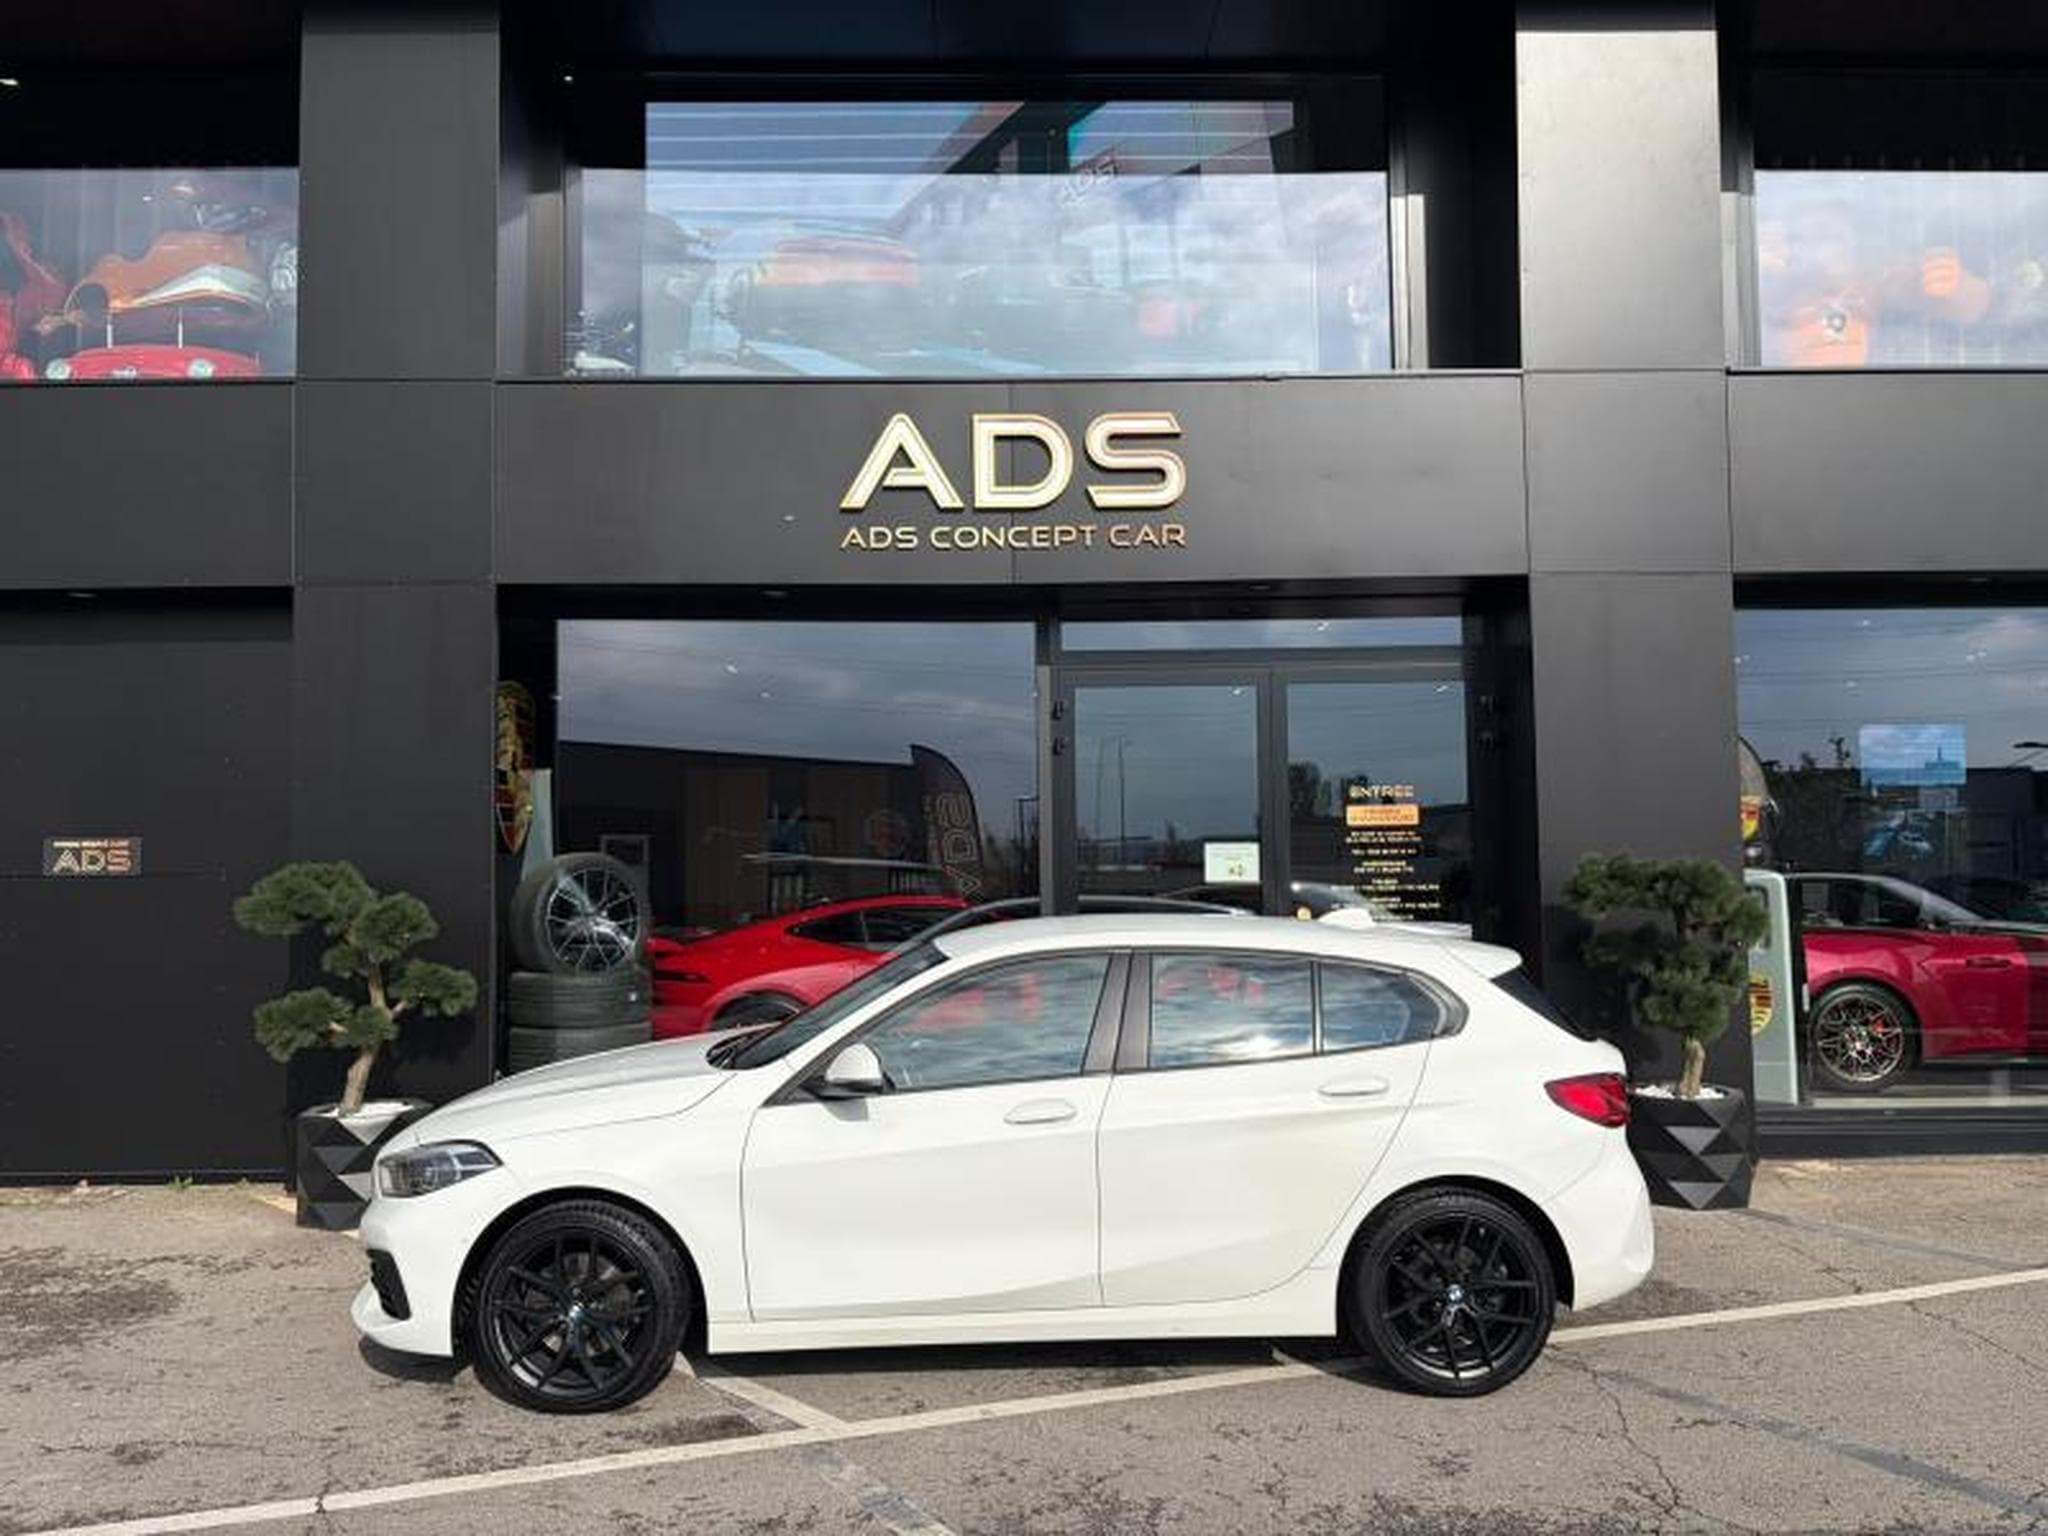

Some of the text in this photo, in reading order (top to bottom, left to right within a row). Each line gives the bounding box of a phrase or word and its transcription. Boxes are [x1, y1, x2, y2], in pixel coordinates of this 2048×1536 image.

[839, 412, 1187, 511] ADS
[841, 523, 1187, 549] ADS CONCEPT CAR
[53, 849, 132, 872] ADS
